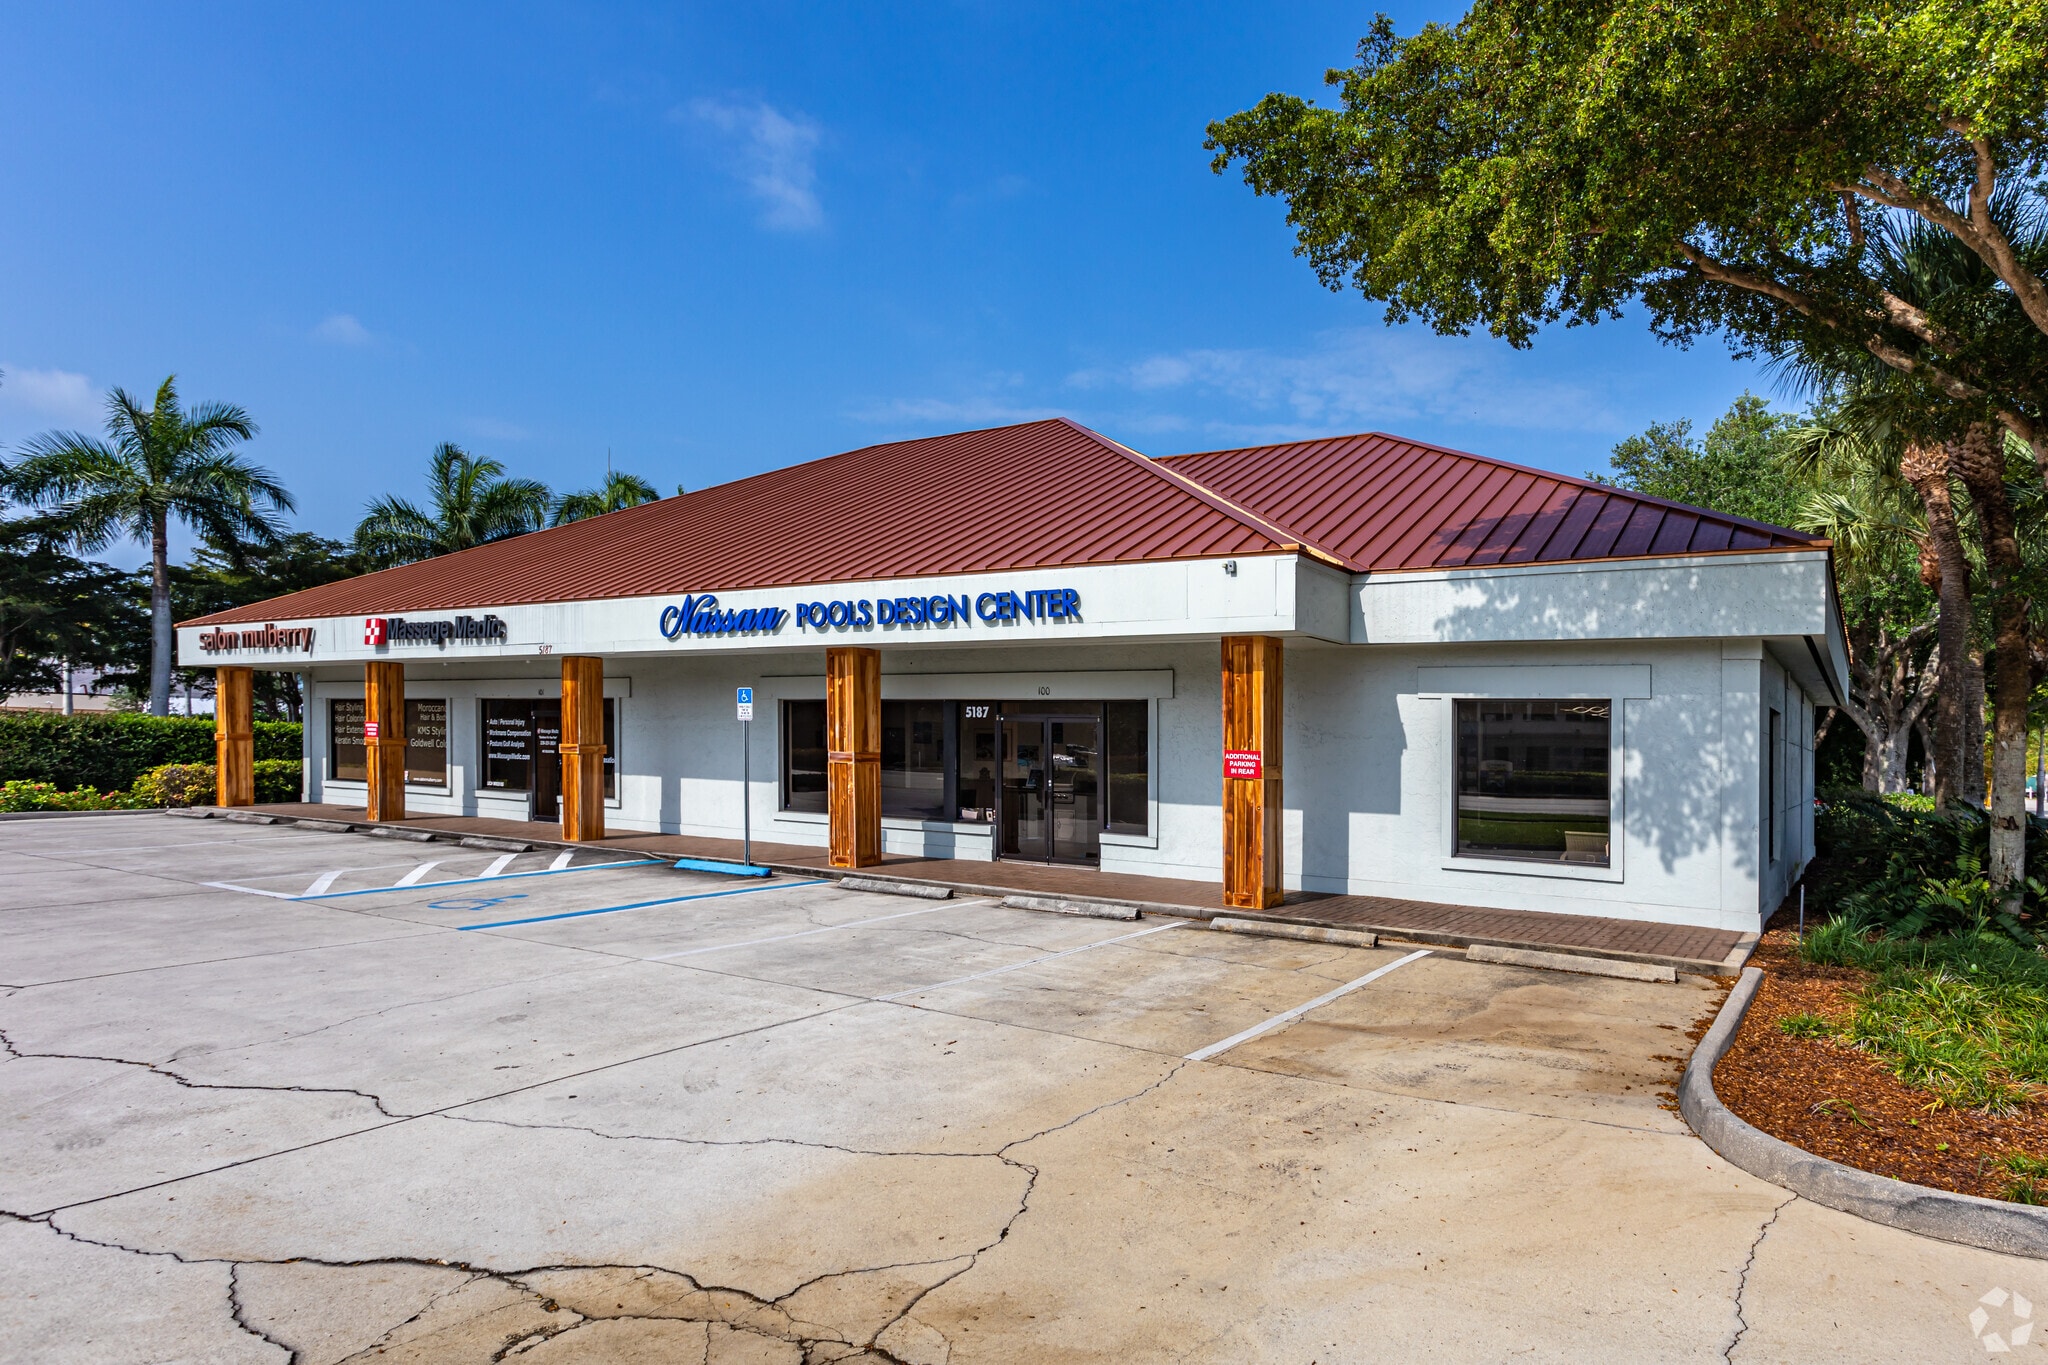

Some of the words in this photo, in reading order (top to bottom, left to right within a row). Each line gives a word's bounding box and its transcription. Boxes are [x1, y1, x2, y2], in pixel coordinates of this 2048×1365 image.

[660, 594, 787, 637] Nassau
[796, 599, 872, 628] POOLS
[877, 594, 969, 624] DESIGN
[975, 588, 1080, 621] CENTER
[388, 617, 451, 645] Massage
[455, 614, 507, 639] Medic
[199, 627, 239, 651] salon
[241, 623, 314, 653] mulberry
[539, 645, 553, 655] 5187
[1038, 686, 1051, 696] 100
[335, 703, 346, 711] Hair
[346, 702, 364, 713] Styling
[965, 706, 990, 719] 5187
[335, 714, 346, 722] Hair
[335, 725, 346, 733] Hair
[417, 726, 431, 735] KMS
[410, 738, 435, 748] Goldwell
